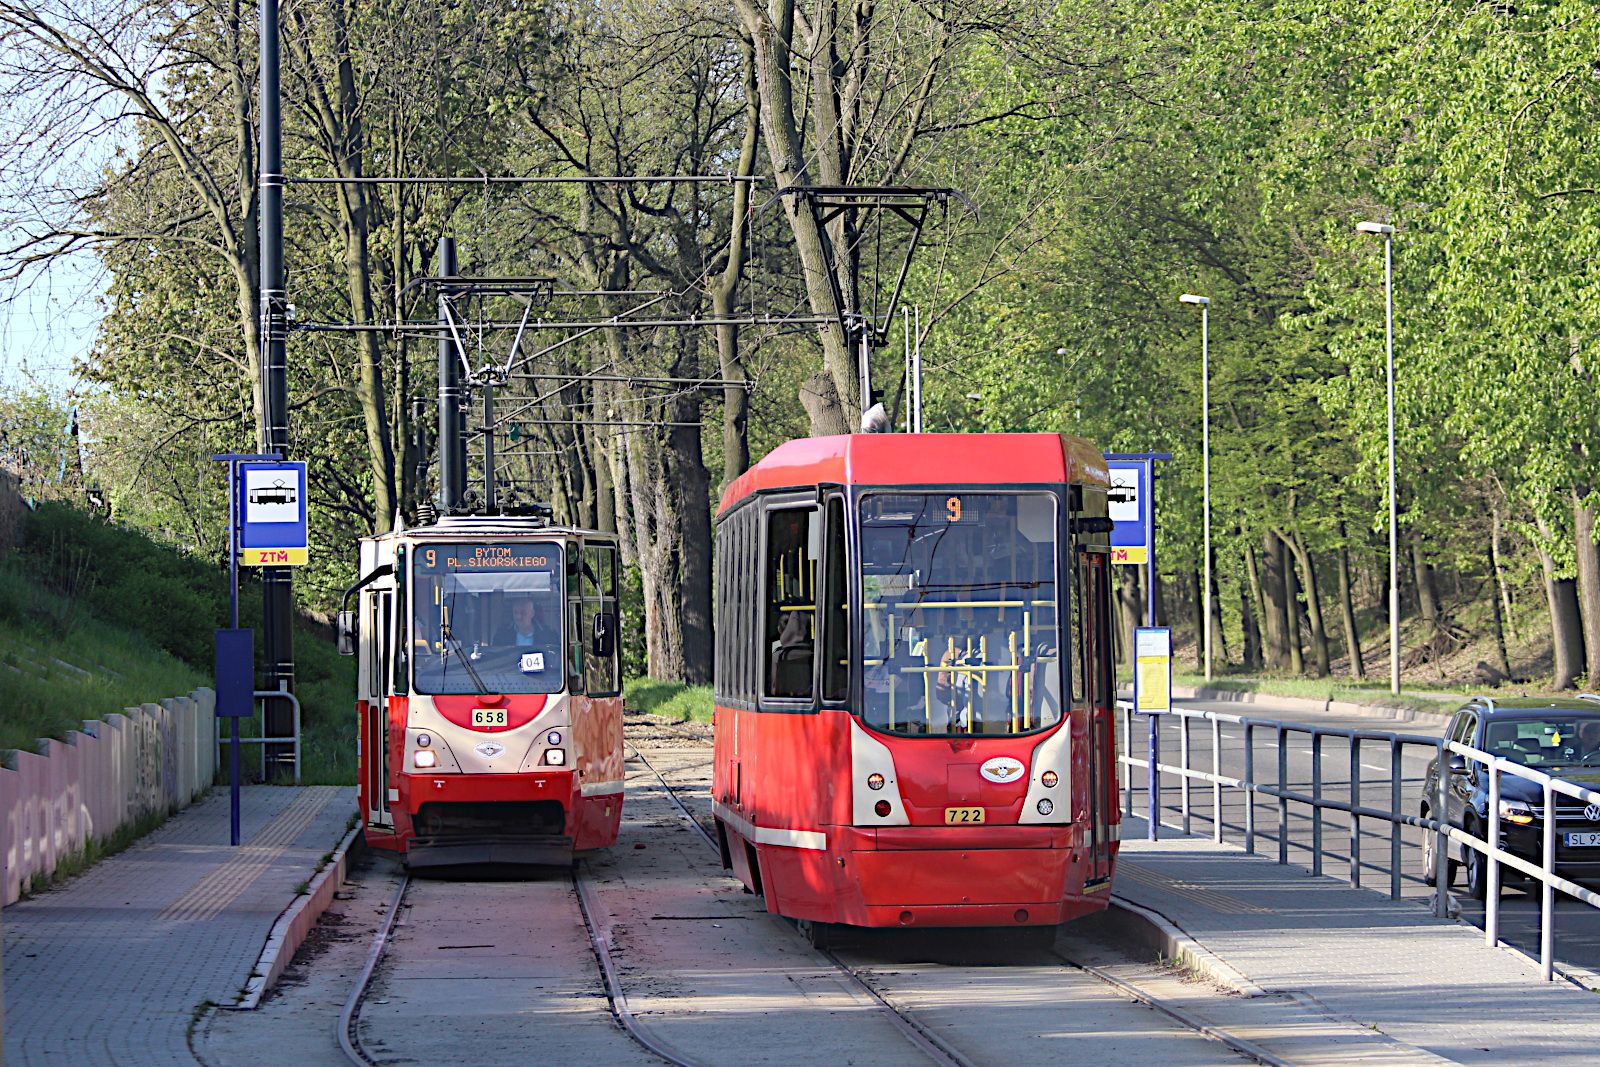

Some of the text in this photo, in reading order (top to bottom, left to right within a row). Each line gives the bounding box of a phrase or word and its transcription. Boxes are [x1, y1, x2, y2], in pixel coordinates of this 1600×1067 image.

[946, 497, 962, 522] 9
[260, 550, 288, 562] ZTM
[425, 549, 436, 568] 9
[475, 547, 512, 558] BYTOM
[1110, 549, 1128, 561] TM
[526, 656, 540, 668] 04
[475, 712, 504, 723] 658
[949, 809, 981, 822] 722
[1571, 834, 1586, 845] SL
